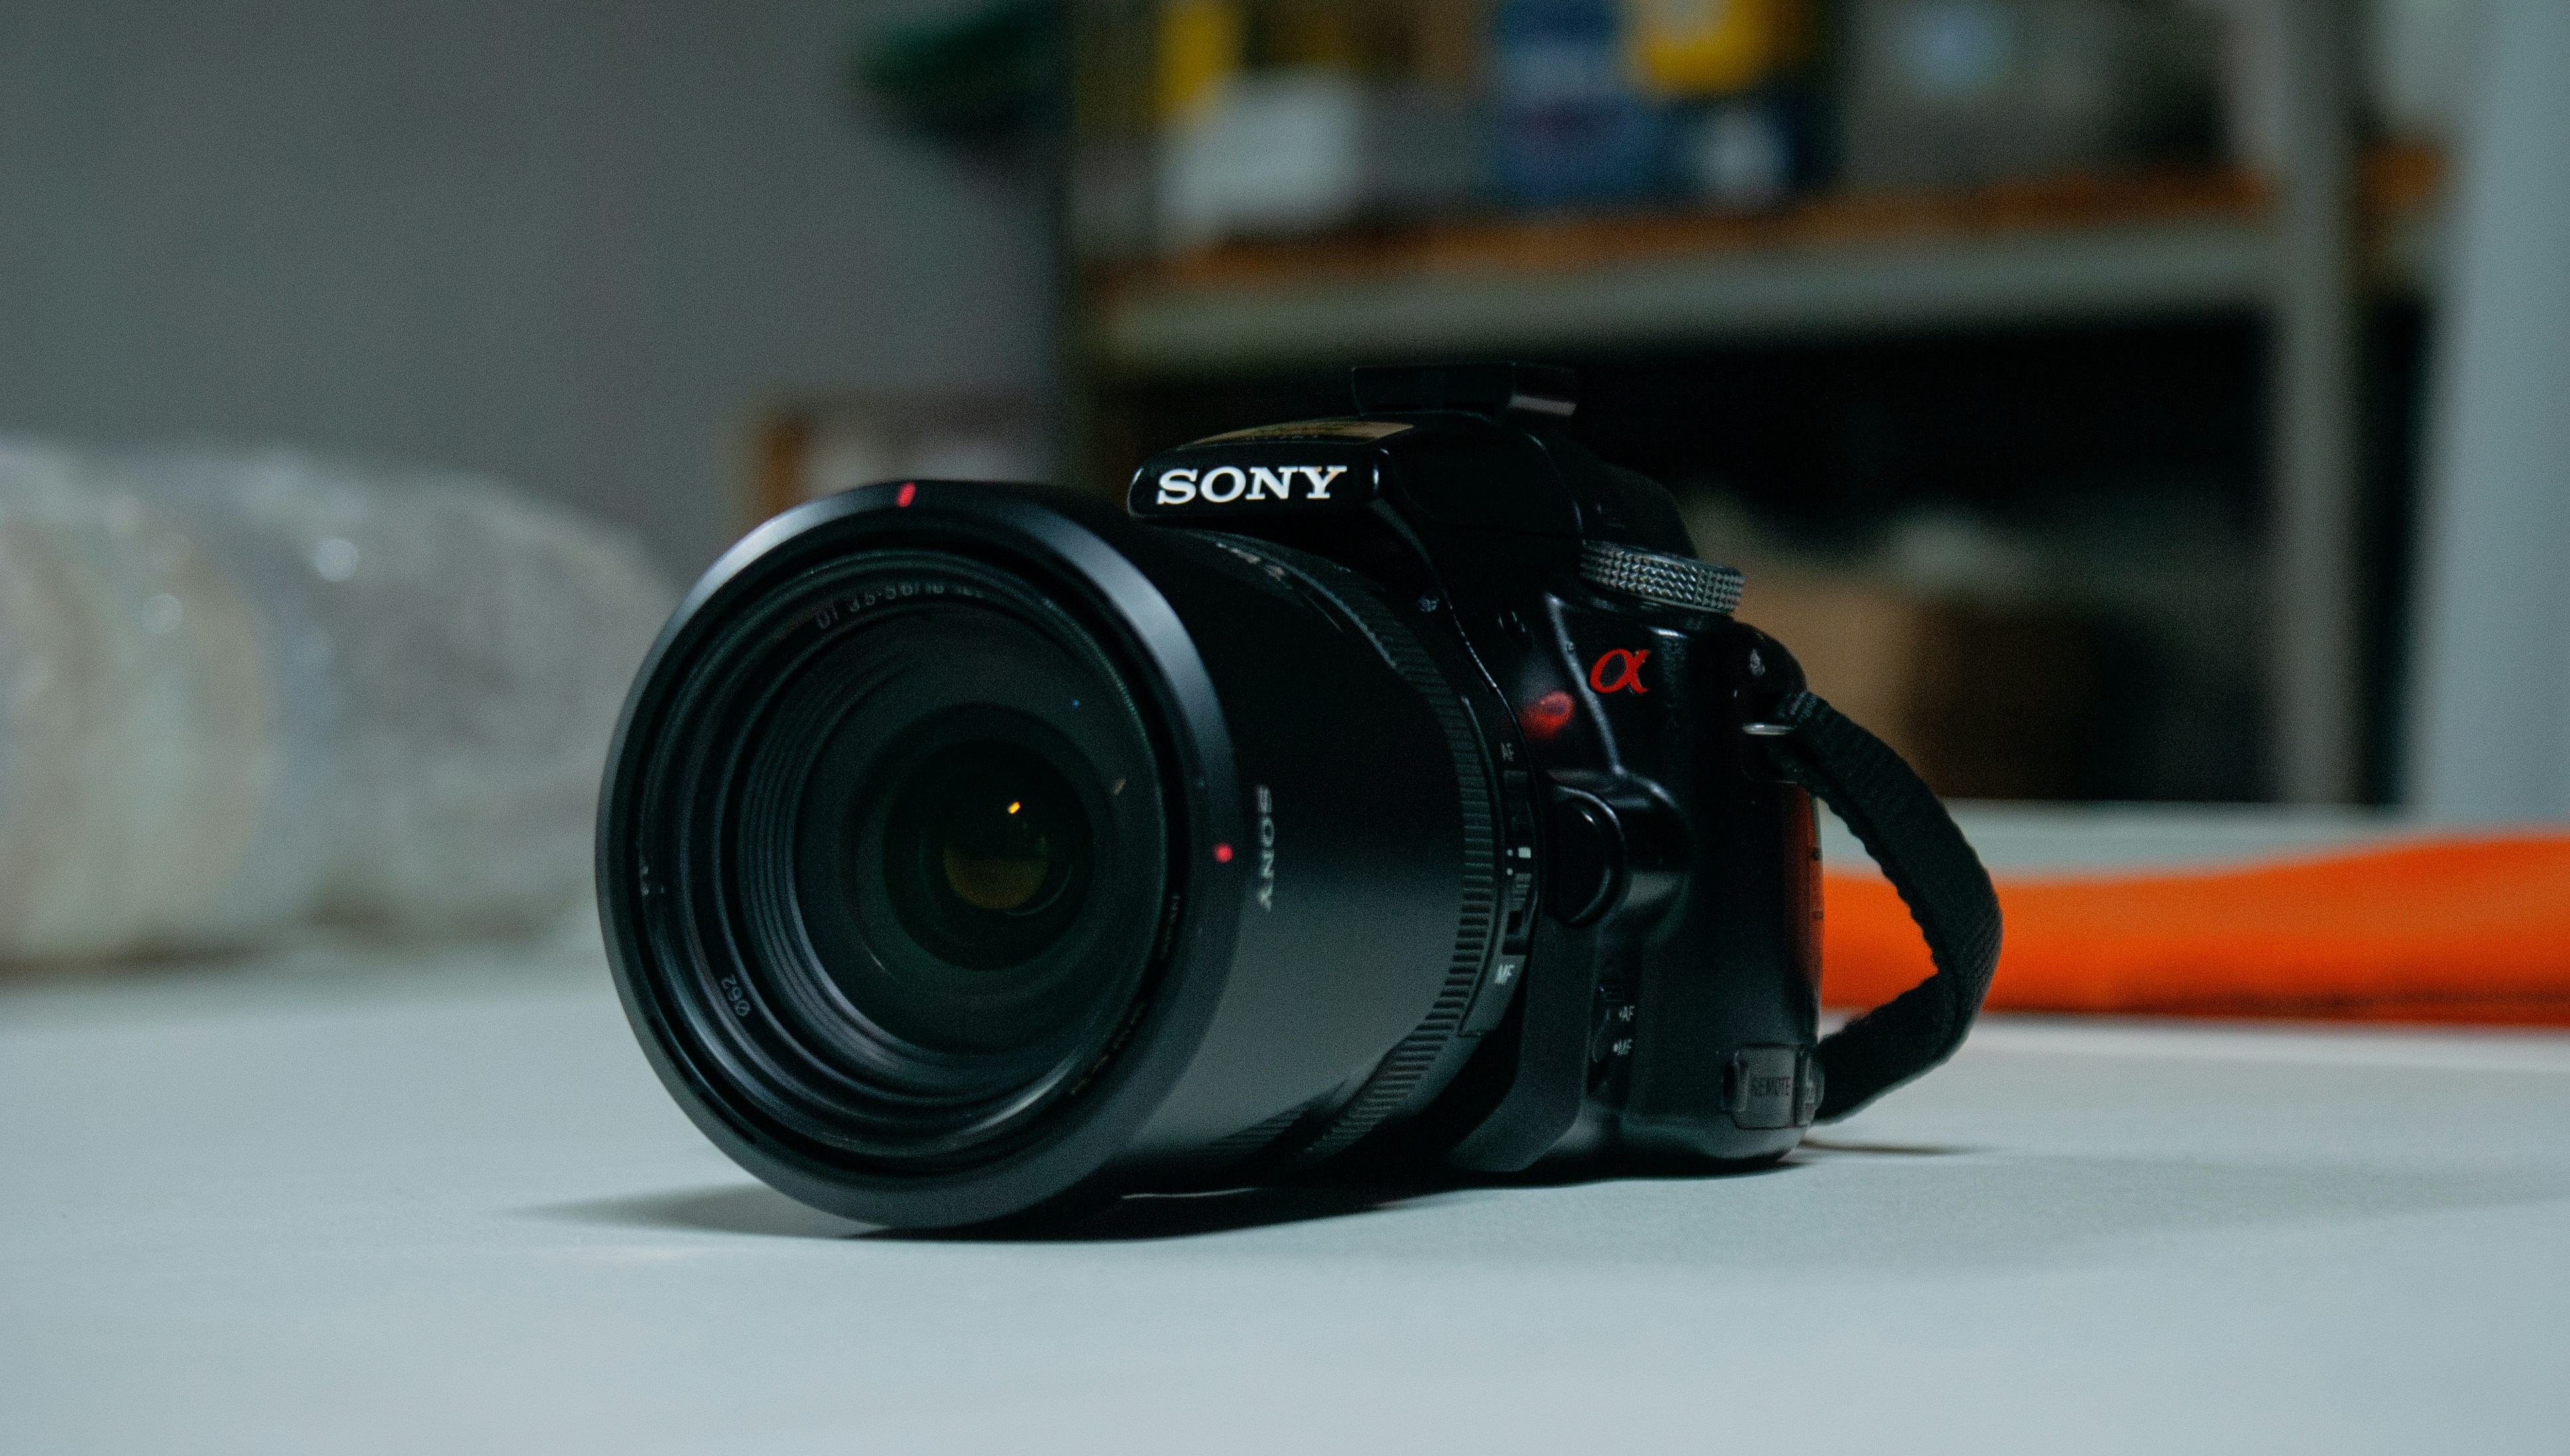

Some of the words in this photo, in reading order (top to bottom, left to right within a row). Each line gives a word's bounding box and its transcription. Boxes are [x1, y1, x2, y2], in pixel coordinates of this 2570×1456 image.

[1156, 465, 1348, 504] SONY
[1500, 742, 1515, 763] AF
[1254, 784, 1275, 912] SONY
[1494, 963, 1515, 985] MF
[1750, 1075, 1791, 1098] REMOTE
